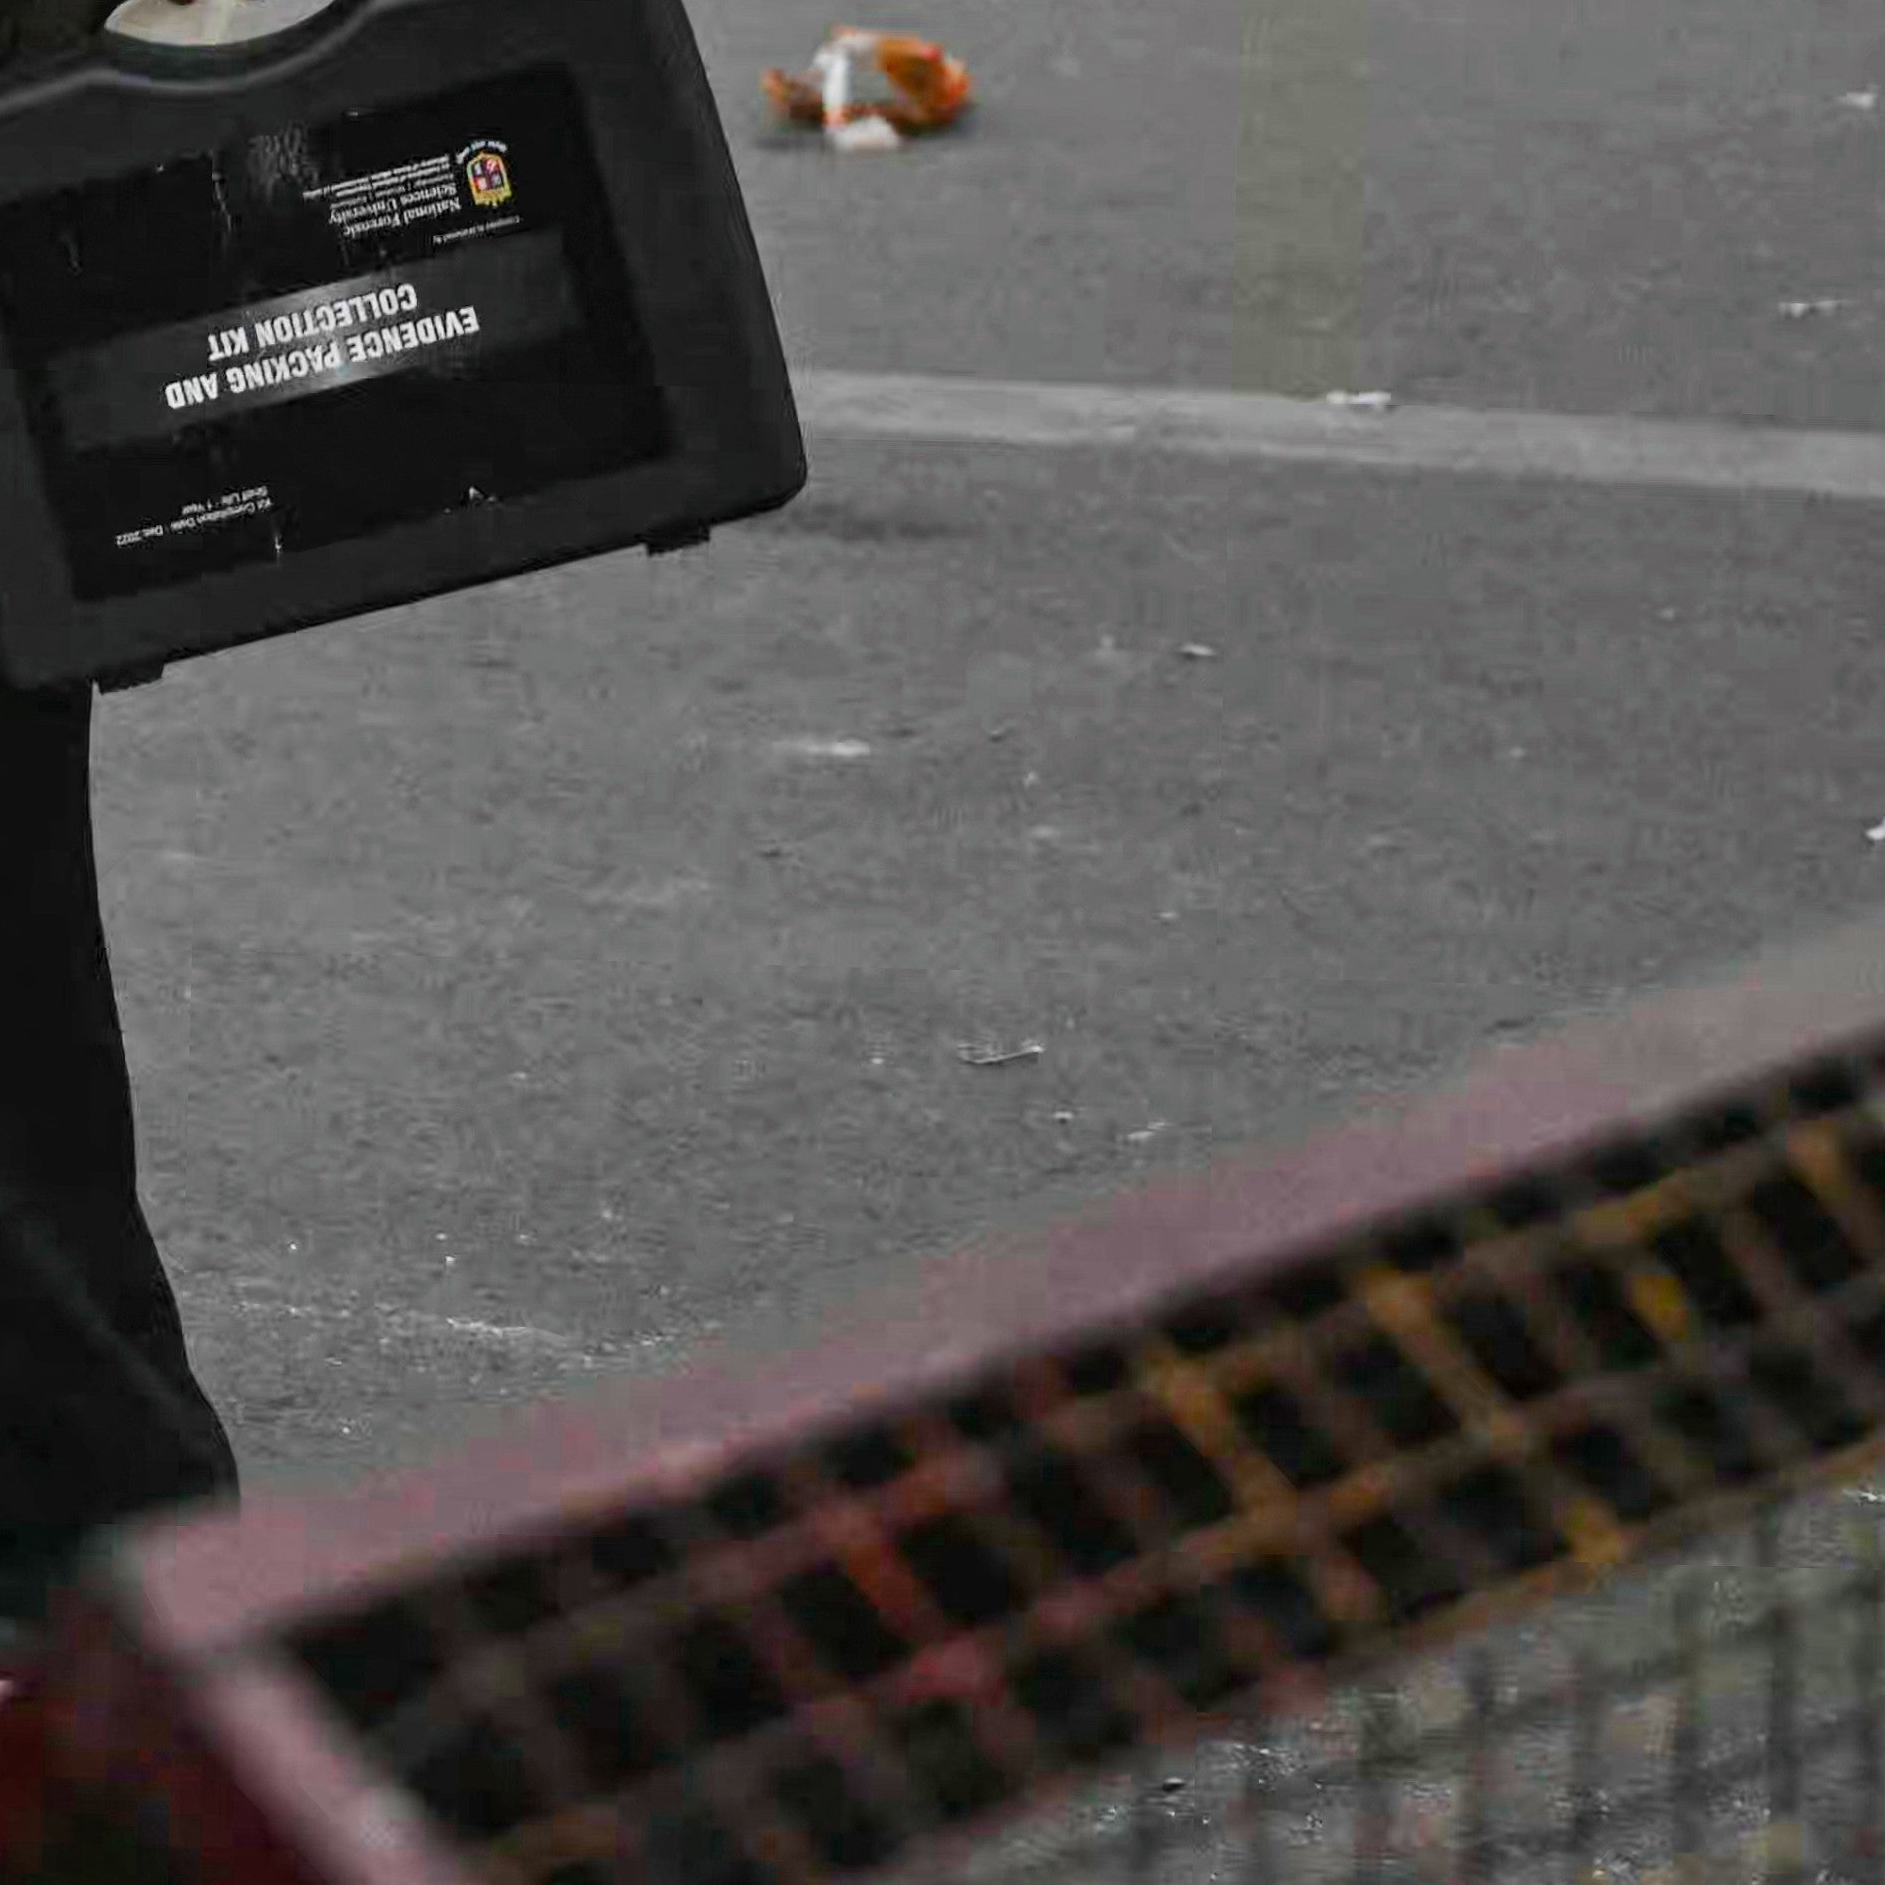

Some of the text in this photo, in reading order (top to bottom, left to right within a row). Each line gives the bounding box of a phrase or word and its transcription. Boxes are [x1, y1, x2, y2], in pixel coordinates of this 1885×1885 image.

[400, 183, 457, 206] Sciences
[329, 197, 398, 225] University
[404, 196, 461, 225] National
[342, 212, 402, 238] Forensic
[207, 283, 418, 361] COLLECTION KIT
[164, 306, 480, 410] EVIDENCE PACKING AND
